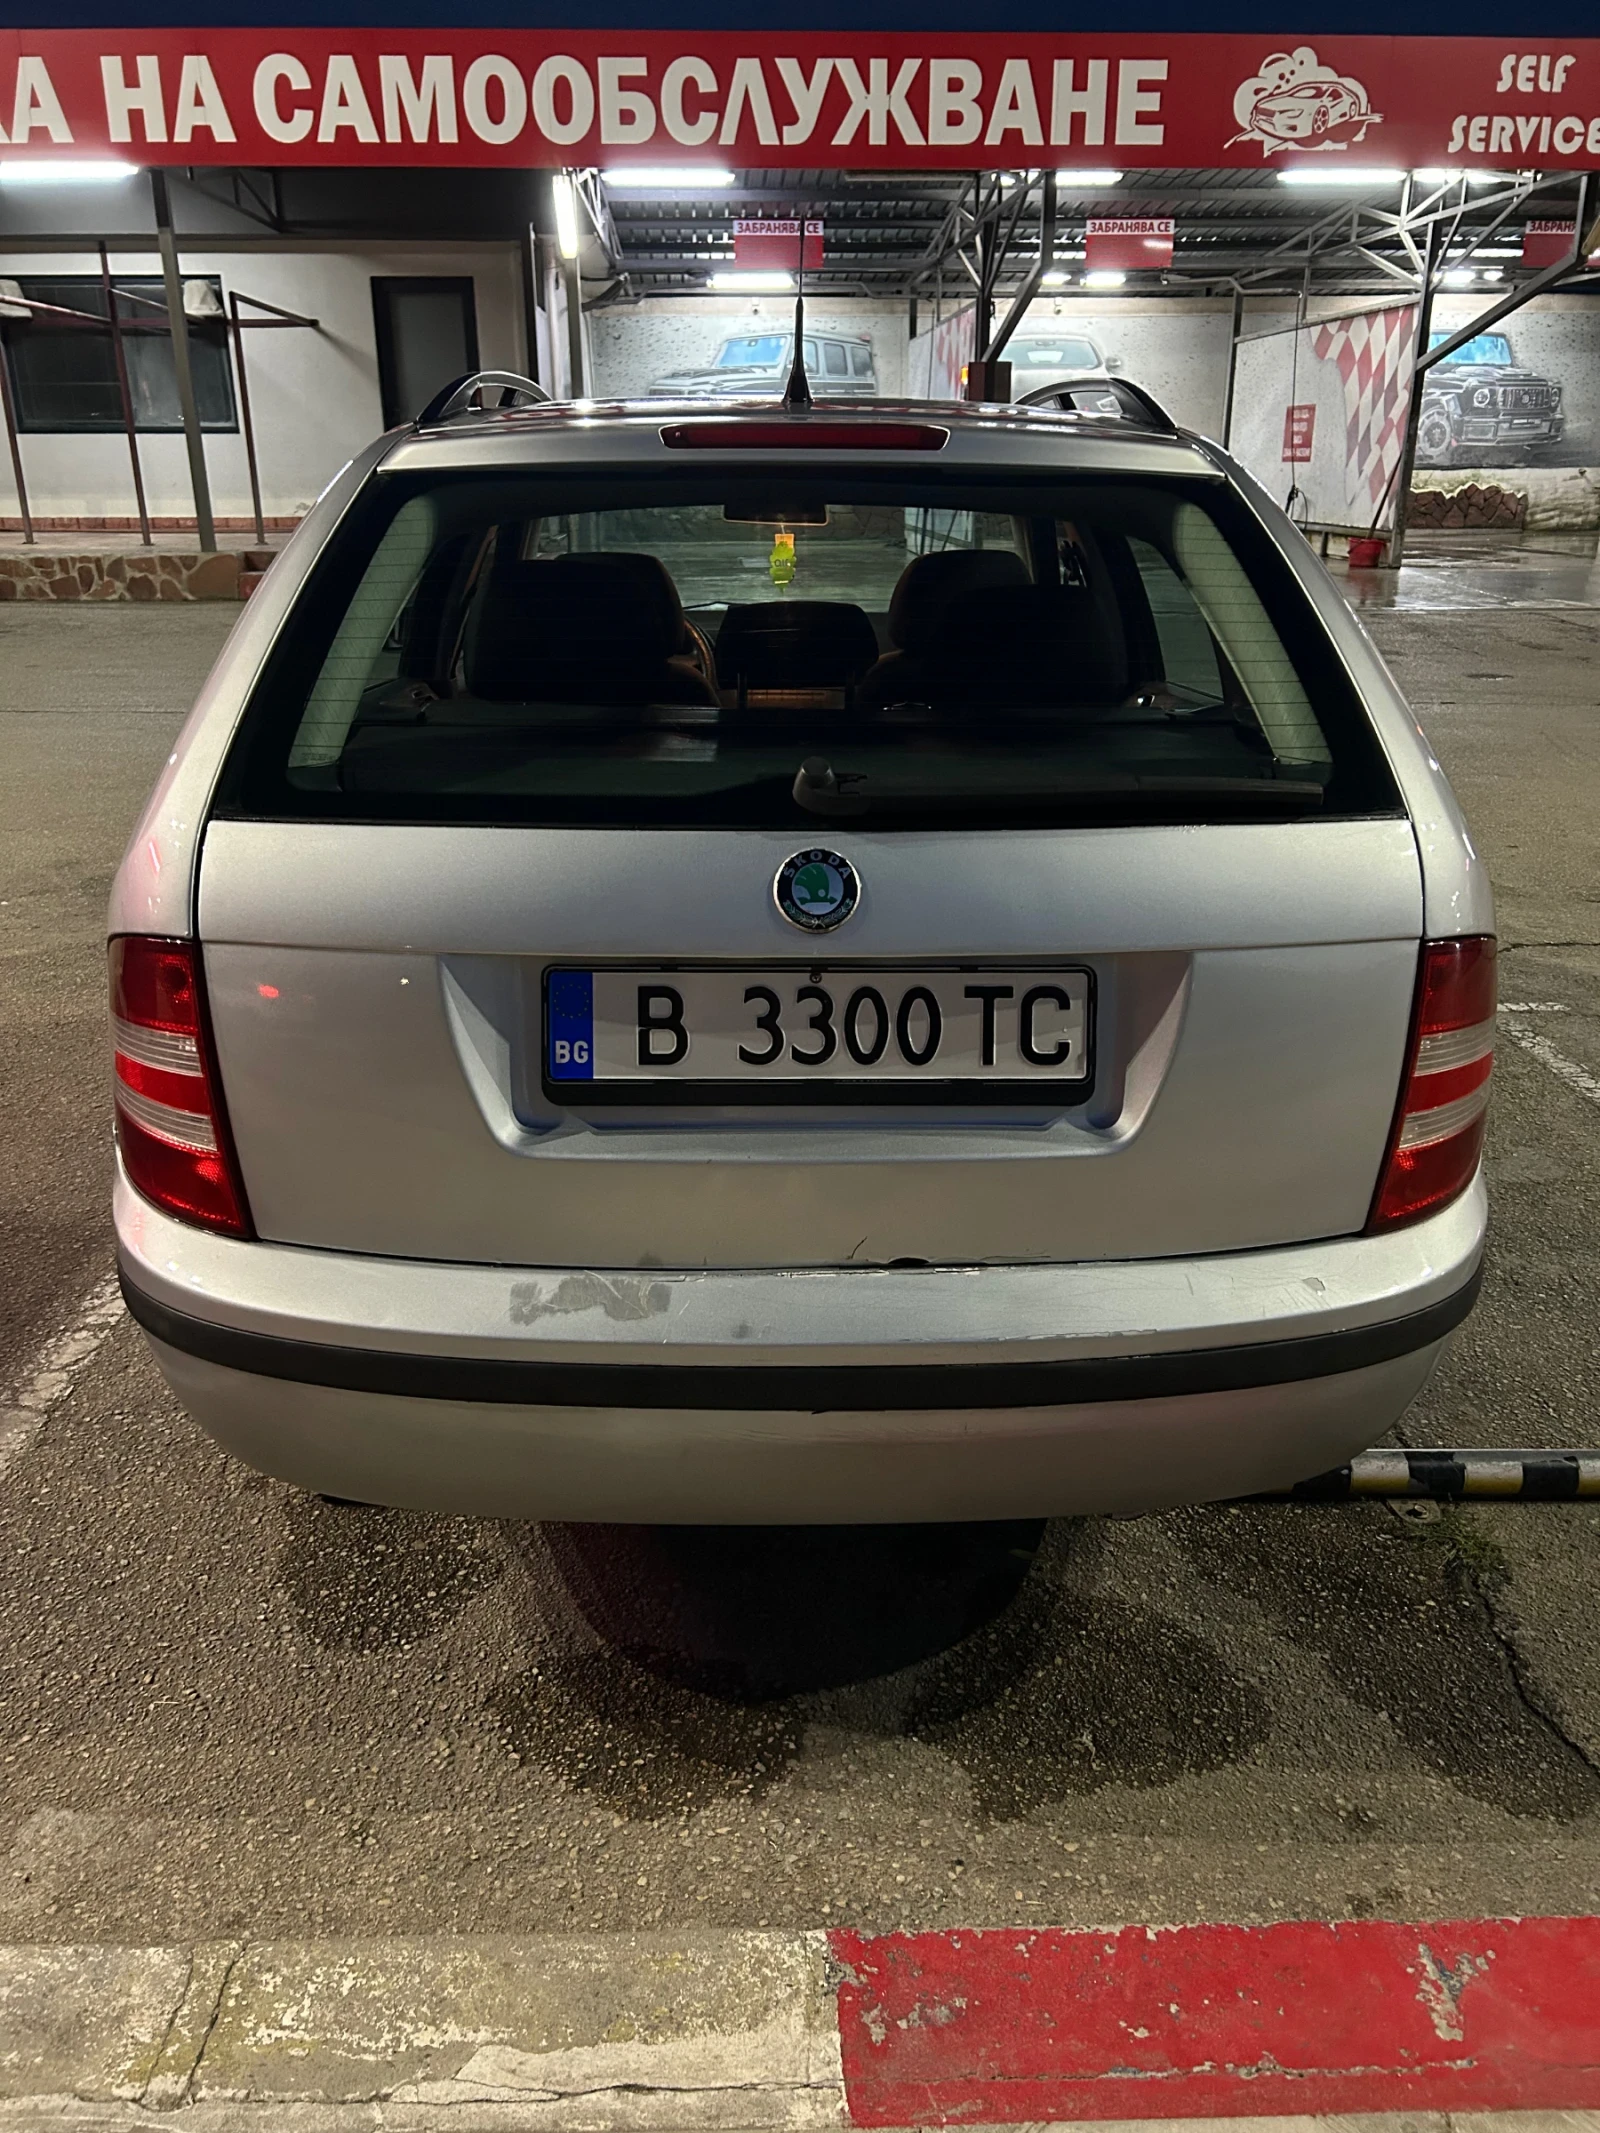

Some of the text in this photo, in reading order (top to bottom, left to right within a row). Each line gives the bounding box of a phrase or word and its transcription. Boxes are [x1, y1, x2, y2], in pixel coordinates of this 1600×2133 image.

[1496, 54, 1577, 93] SELF
[0, 53, 1168, 146] А НА САМООБСЛУЖВАНЕ
[1447, 115, 1600, 154] SERVICE
[806, 222, 820, 234] СЕ
[1090, 221, 1171, 233] ЗАБРАНЯВА СЕ
[637, 985, 1072, 1067] B 3300 TC
[554, 1040, 589, 1064] BG
